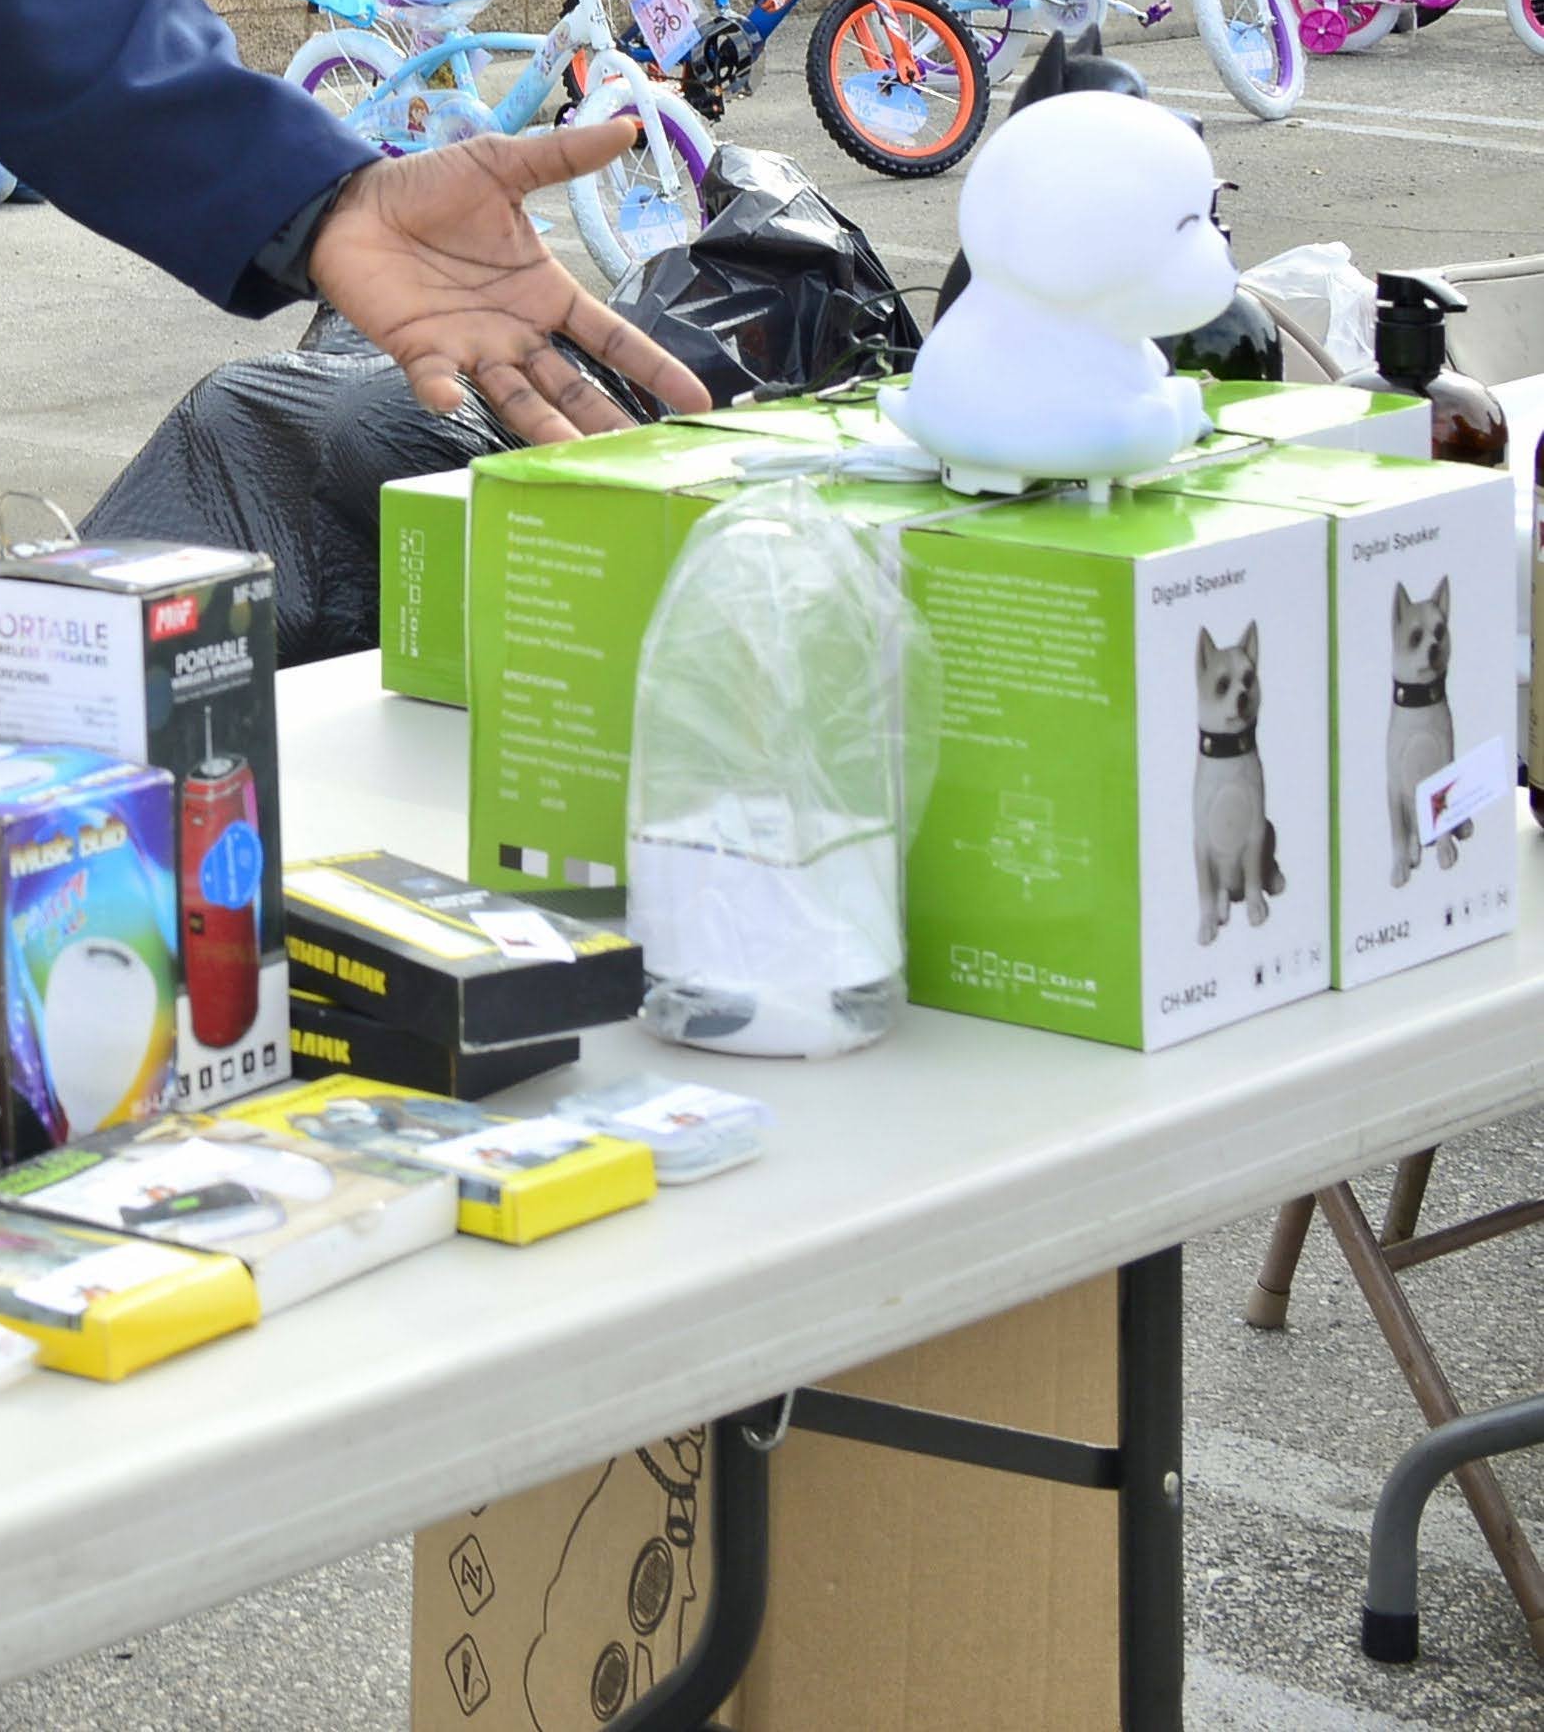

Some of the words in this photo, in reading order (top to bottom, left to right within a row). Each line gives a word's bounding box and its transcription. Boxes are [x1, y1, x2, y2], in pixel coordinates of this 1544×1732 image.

[1352, 536, 1390, 563] Digital
[1392, 524, 1441, 552] Speaker
[1151, 578, 1191, 608] Digital
[1194, 567, 1247, 596] Speaker
[174, 635, 249, 676] PORTABLE
[285, 935, 336, 975] OWER
[1355, 920, 1411, 954] CH-M242
[1160, 979, 1218, 1015] CH-M242
